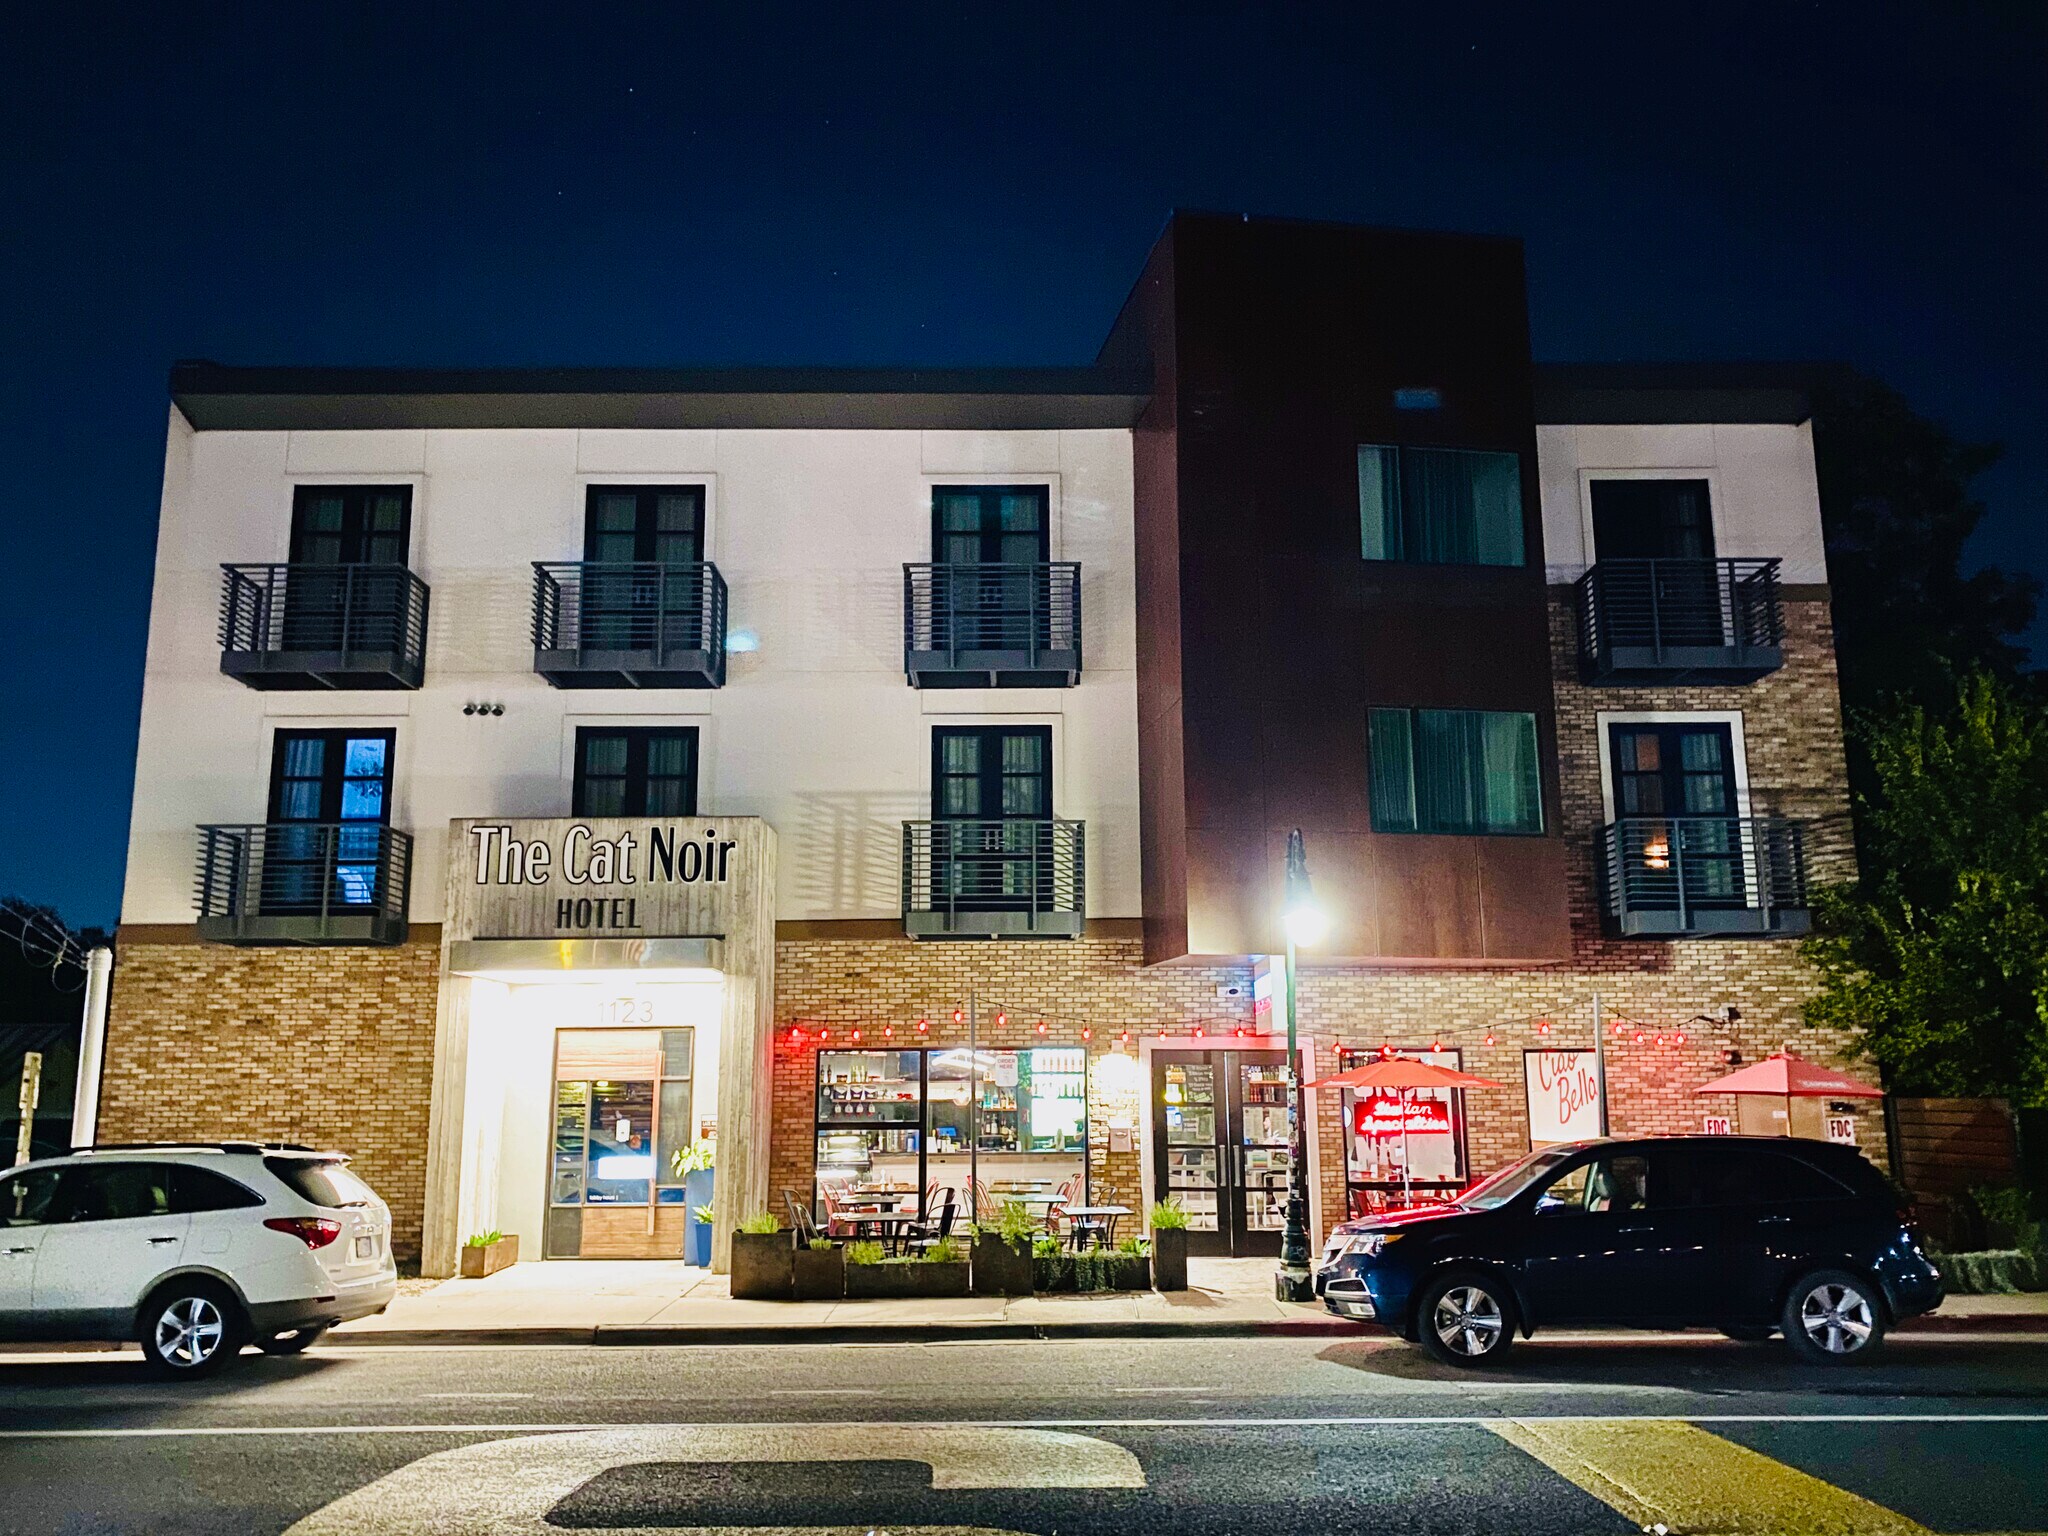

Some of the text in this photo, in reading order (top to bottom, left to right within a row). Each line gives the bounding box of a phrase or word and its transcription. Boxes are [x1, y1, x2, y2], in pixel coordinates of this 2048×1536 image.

[470, 825, 737, 885] The Cat Noir
[556, 898, 641, 929] HOTEL
[598, 1001, 653, 1023] 1123
[1538, 1052, 1579, 1092] Ciao
[1556, 1076, 1598, 1125] Bella
[1707, 1119, 1728, 1135] FDC
[1830, 1120, 1851, 1137] FDC
